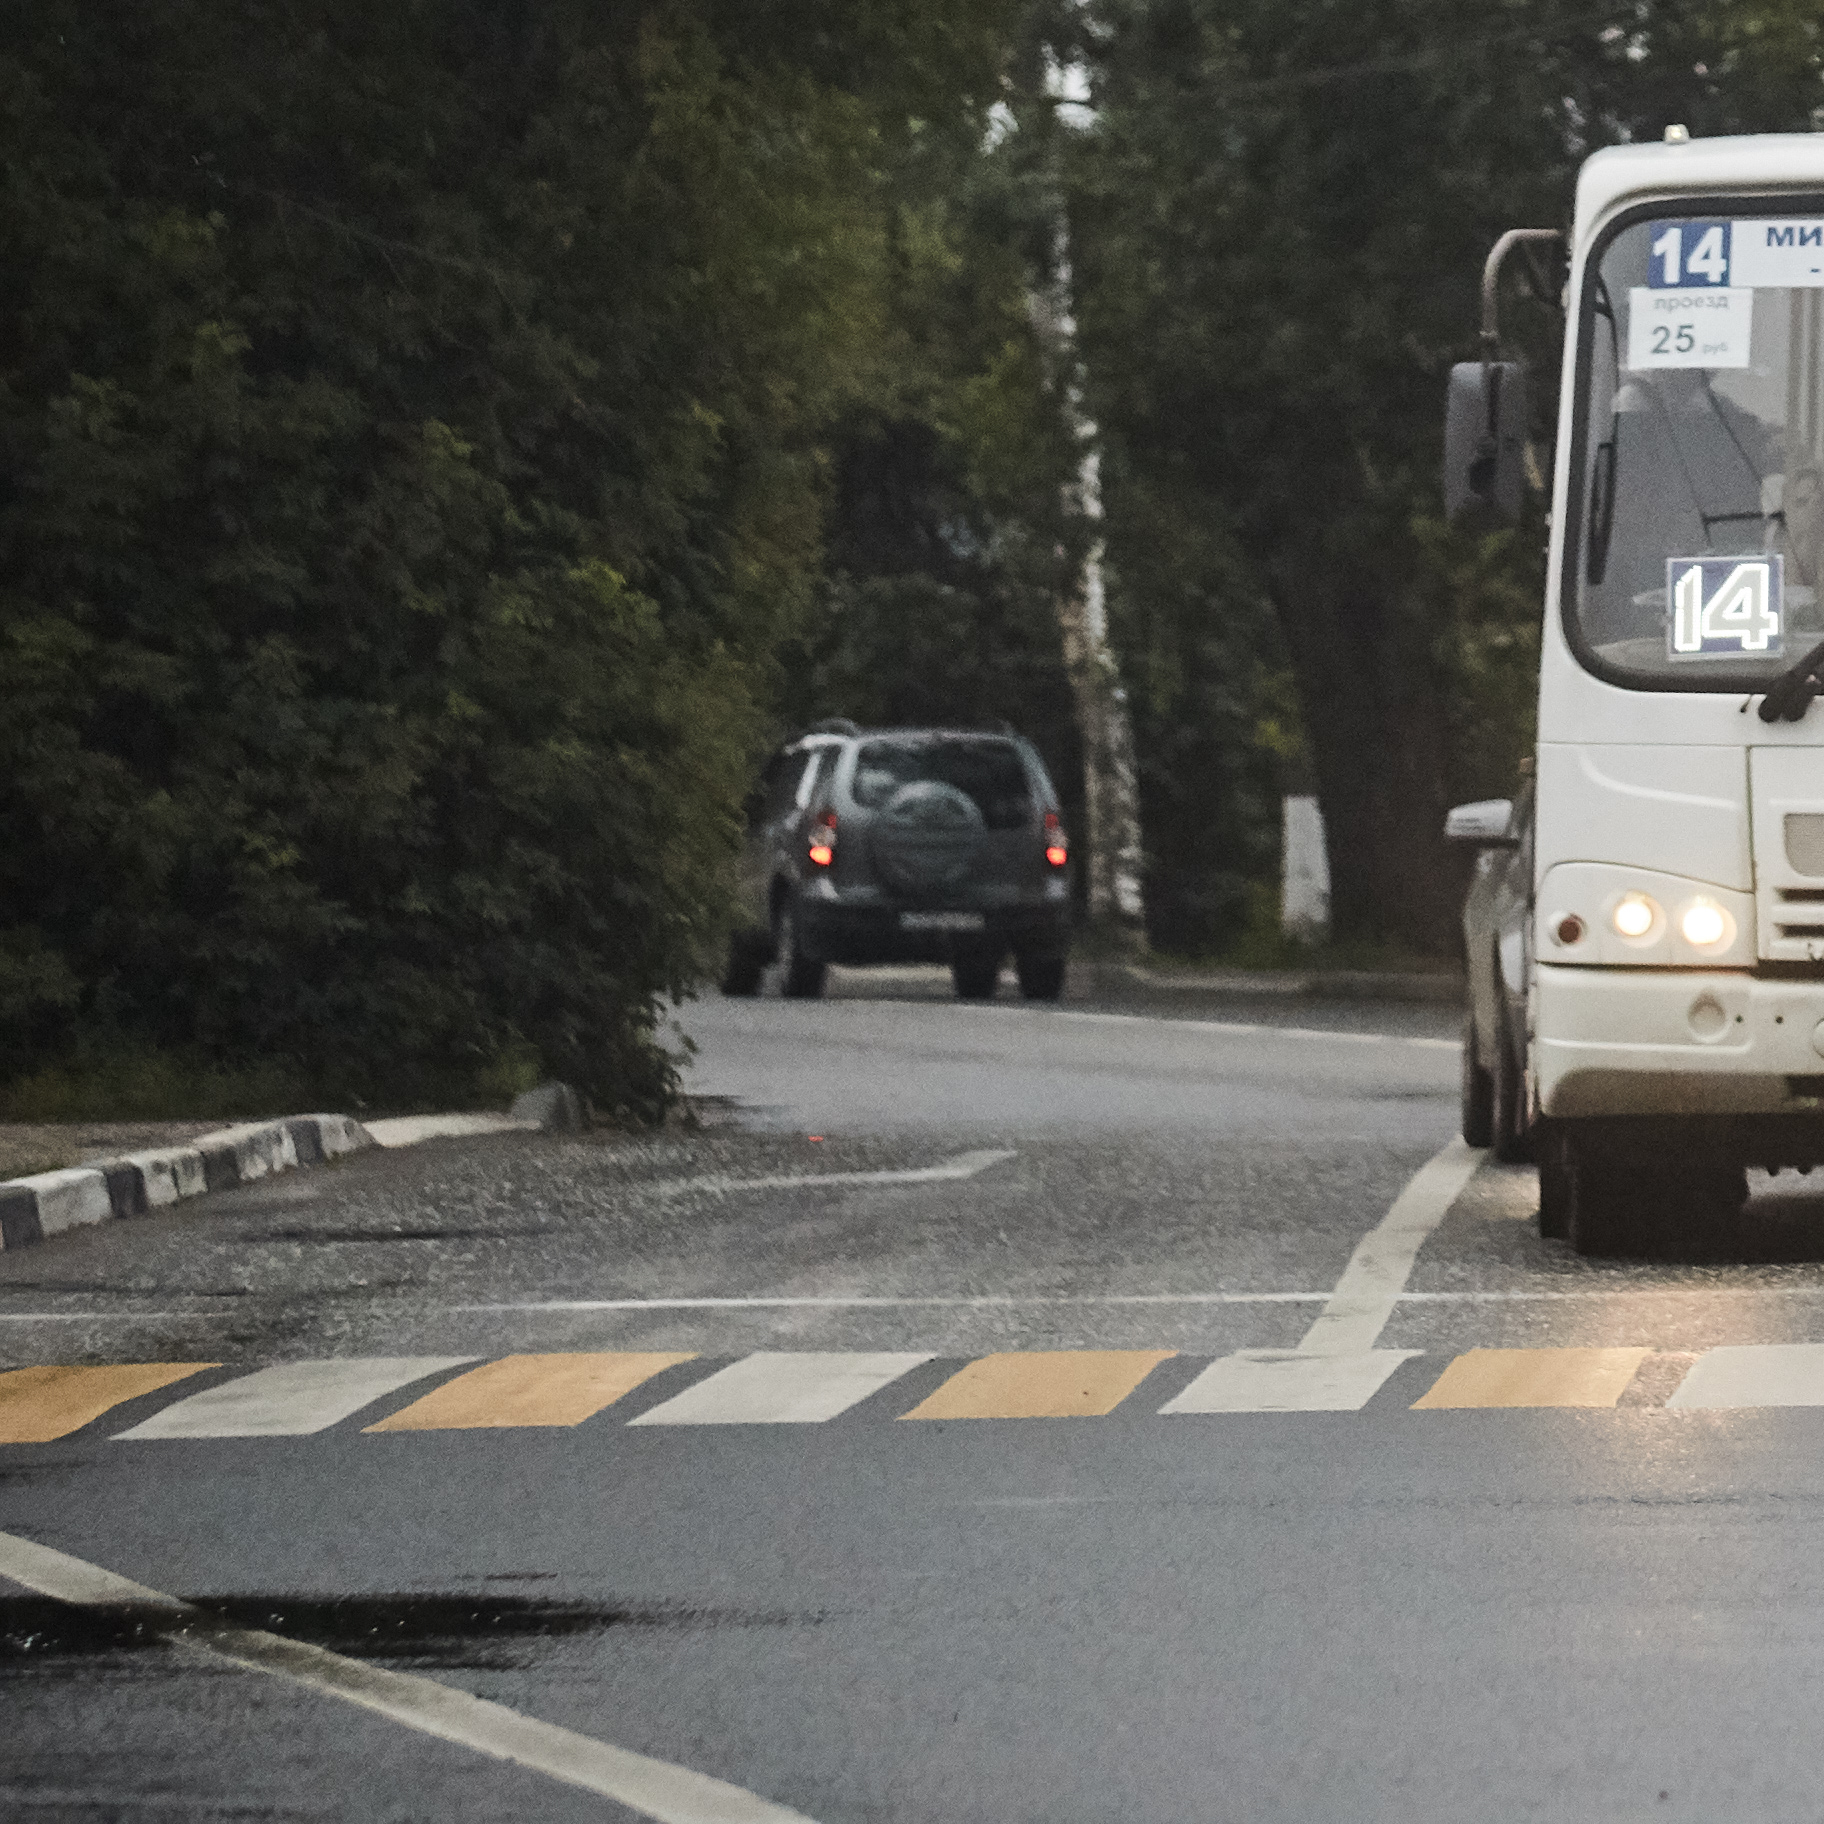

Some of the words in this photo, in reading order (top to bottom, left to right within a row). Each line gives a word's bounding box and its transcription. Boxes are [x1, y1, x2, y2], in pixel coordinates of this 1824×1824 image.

[1652, 226, 1728, 285] 14
[1654, 296, 1729, 313] проезд
[1650, 324, 1695, 354] 25
[1674, 563, 1779, 653] 14
